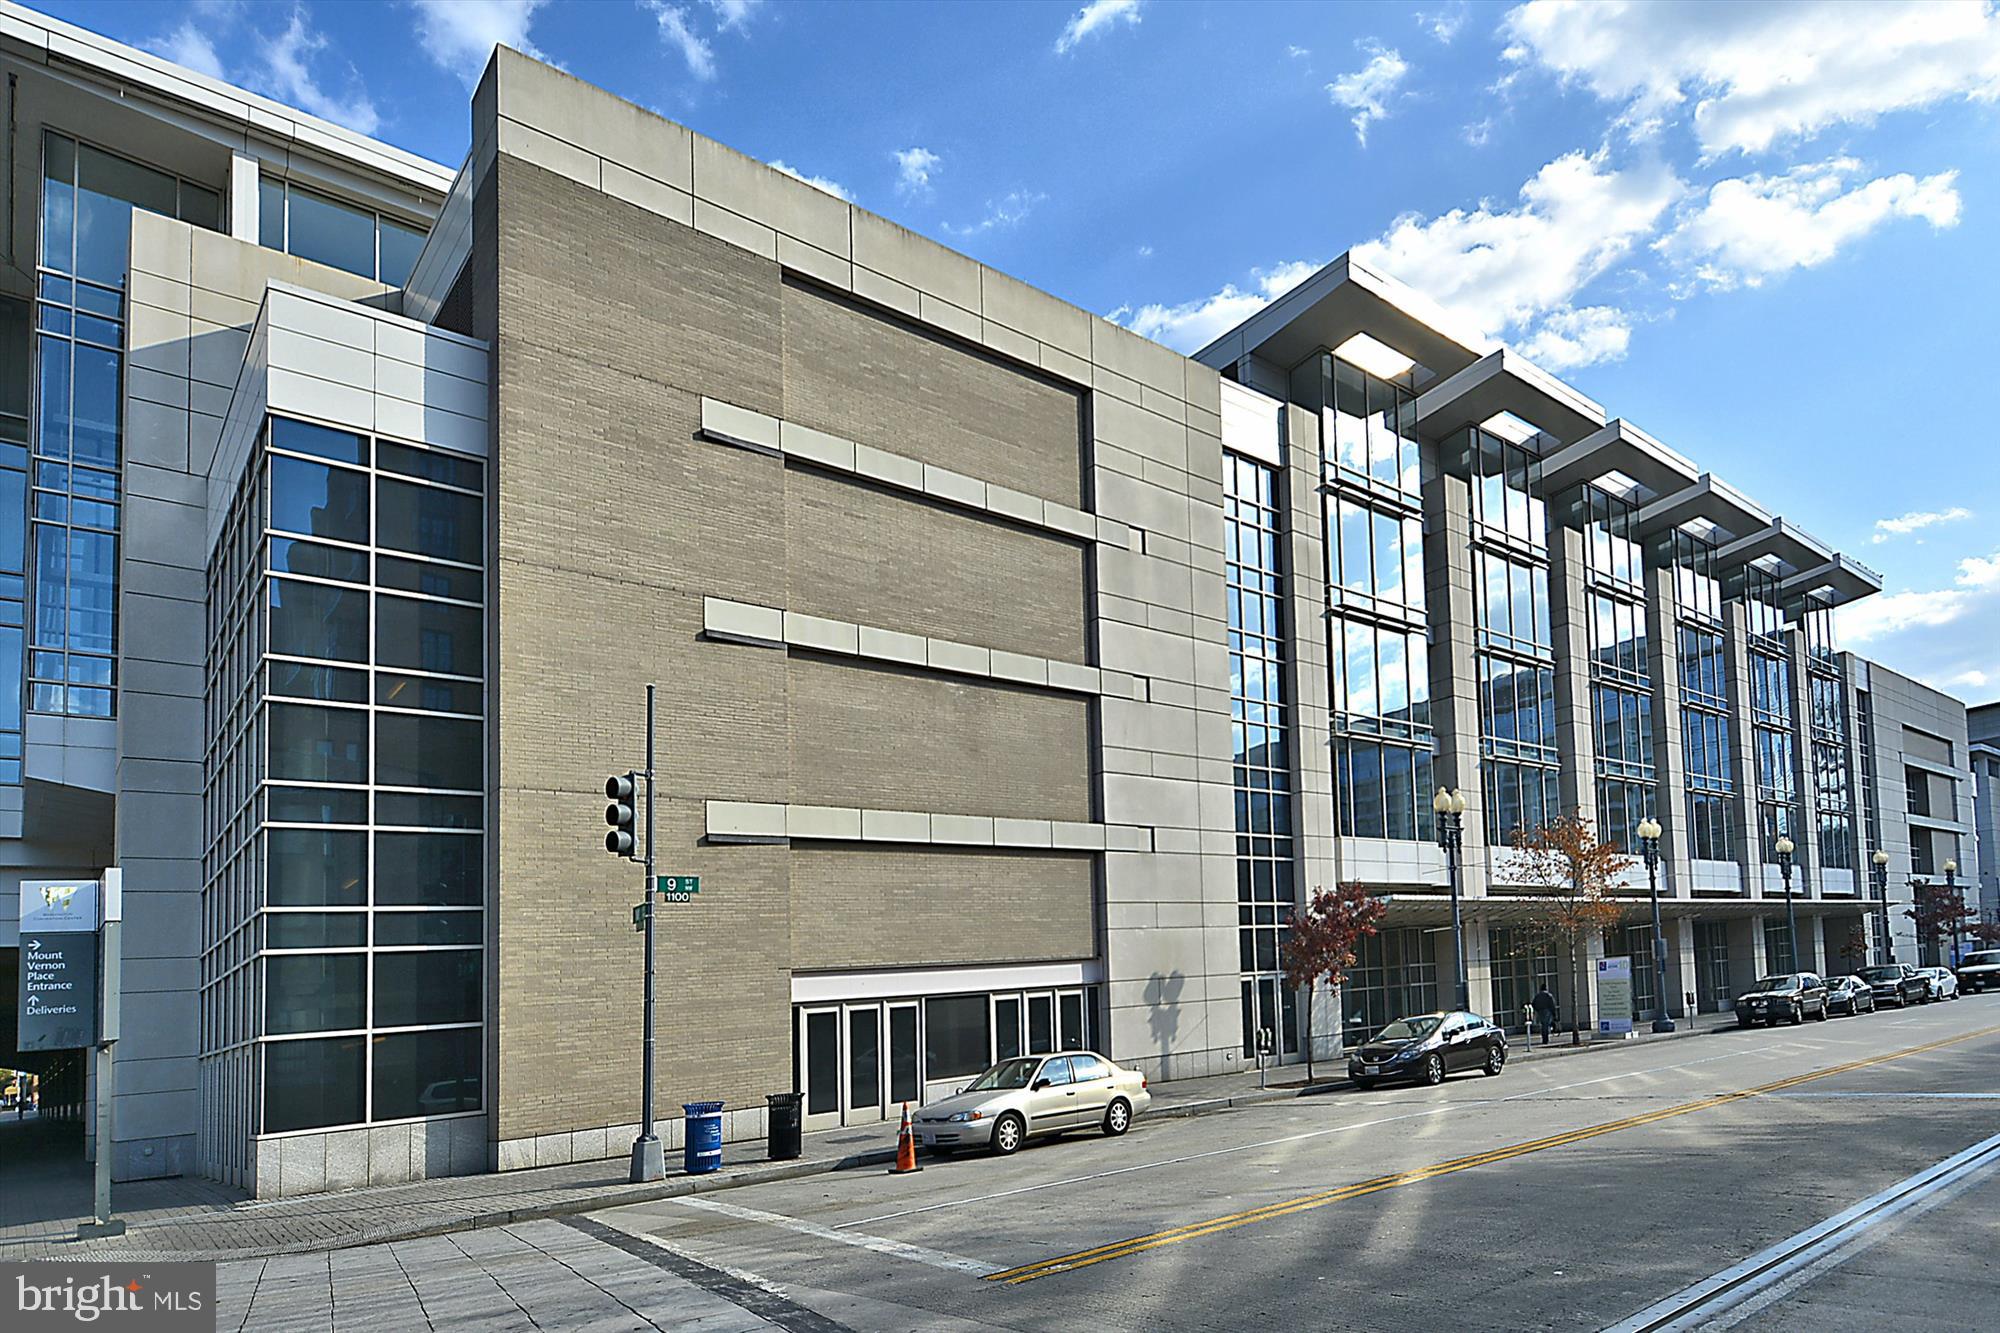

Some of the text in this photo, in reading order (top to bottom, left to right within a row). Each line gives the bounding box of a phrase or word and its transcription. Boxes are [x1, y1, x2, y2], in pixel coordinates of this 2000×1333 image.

[667, 878, 676, 891] 9
[666, 892, 689, 902] 1100
[27, 951, 63, 960] Mount
[27, 962, 66, 970] Vernon
[27, 971, 55, 980] Place
[27, 982, 73, 991] Entrance
[26, 1005, 77, 1015] Deliveries
